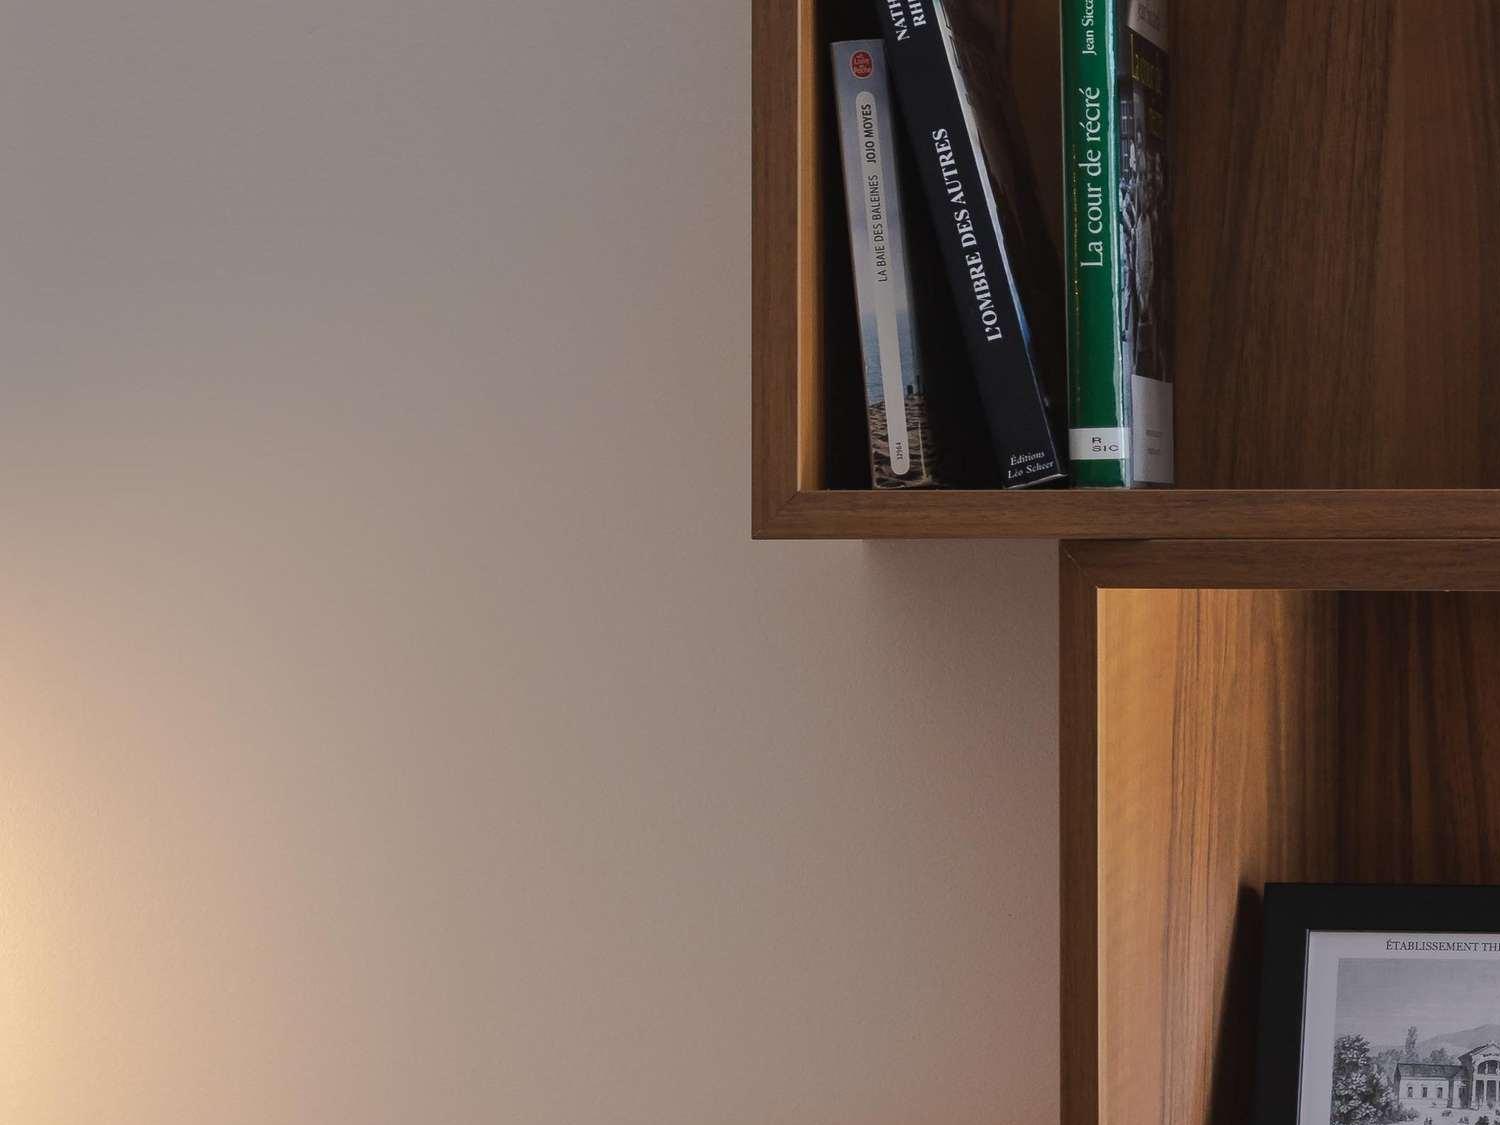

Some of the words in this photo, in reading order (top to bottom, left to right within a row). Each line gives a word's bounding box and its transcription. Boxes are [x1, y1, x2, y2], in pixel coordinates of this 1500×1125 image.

[1082, 30, 1097, 55] Jean
[861, 103, 875, 138] MOYES
[1079, 87, 1101, 142] récré
[865, 140, 877, 163] JOJO
[1078, 149, 1102, 177] de
[932, 128, 966, 205] AUTRES
[868, 174, 882, 221] BALEINES
[1087, 183, 1103, 234] cour
[872, 222, 884, 242] DES
[954, 209, 977, 248] DES
[875, 245, 888, 268] BAIE
[1080, 240, 1104, 267] La
[877, 269, 888, 283] LA
[965, 251, 1002, 342] L'OMBRE
[1386, 939, 1479, 951] ÉTABLISSEMENT
